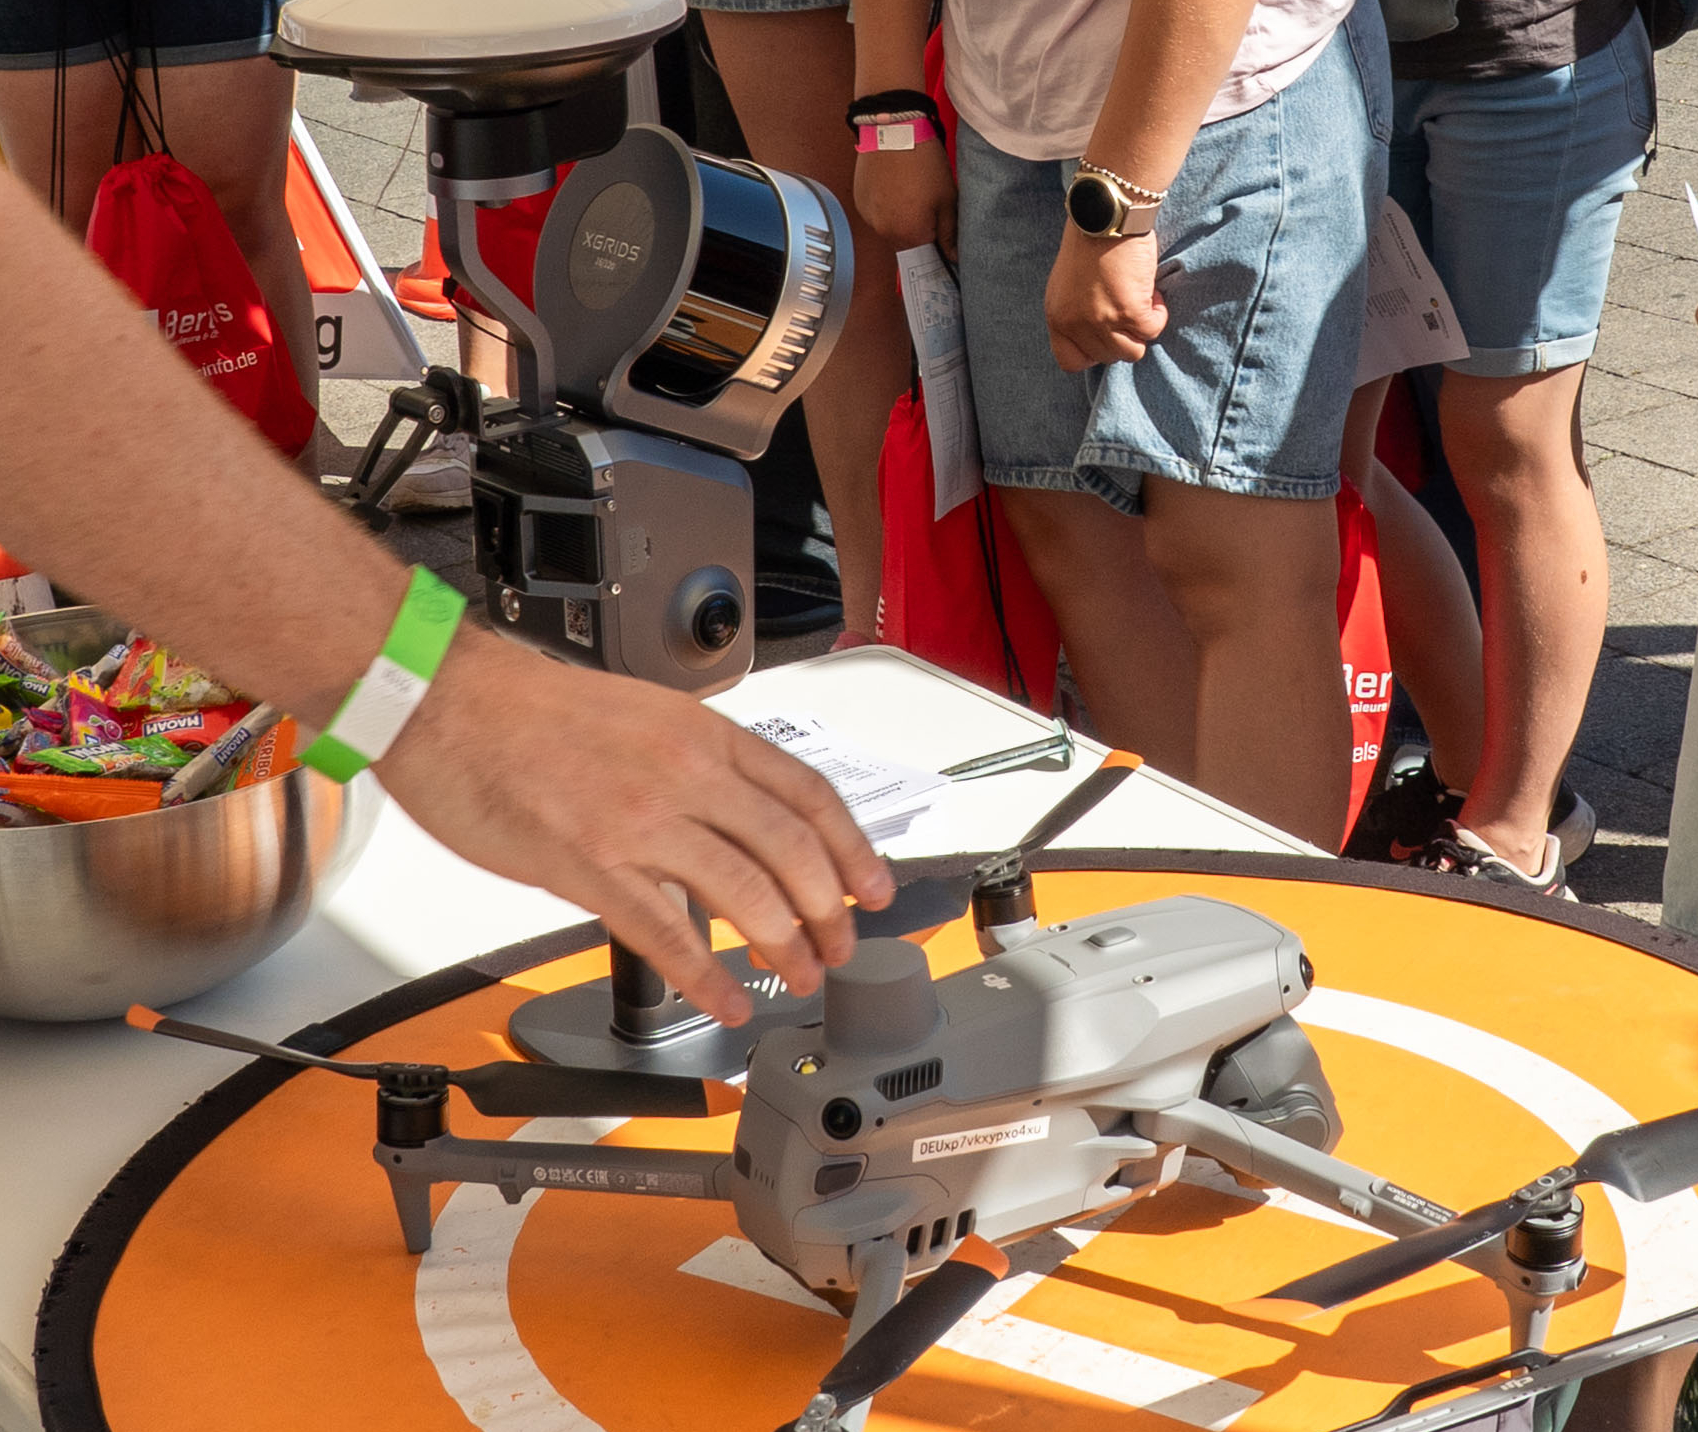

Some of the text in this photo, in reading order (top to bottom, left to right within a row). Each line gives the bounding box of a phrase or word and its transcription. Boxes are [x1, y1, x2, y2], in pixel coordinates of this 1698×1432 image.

[581, 231, 641, 262] XGRIDS
[315, 315, 343, 371] g
[197, 351, 258, 377] -info.de
[1342, 663, 1393, 698] Ber
[144, 715, 201, 736] MAOAM
[215, 728, 250, 766] MAOAM
